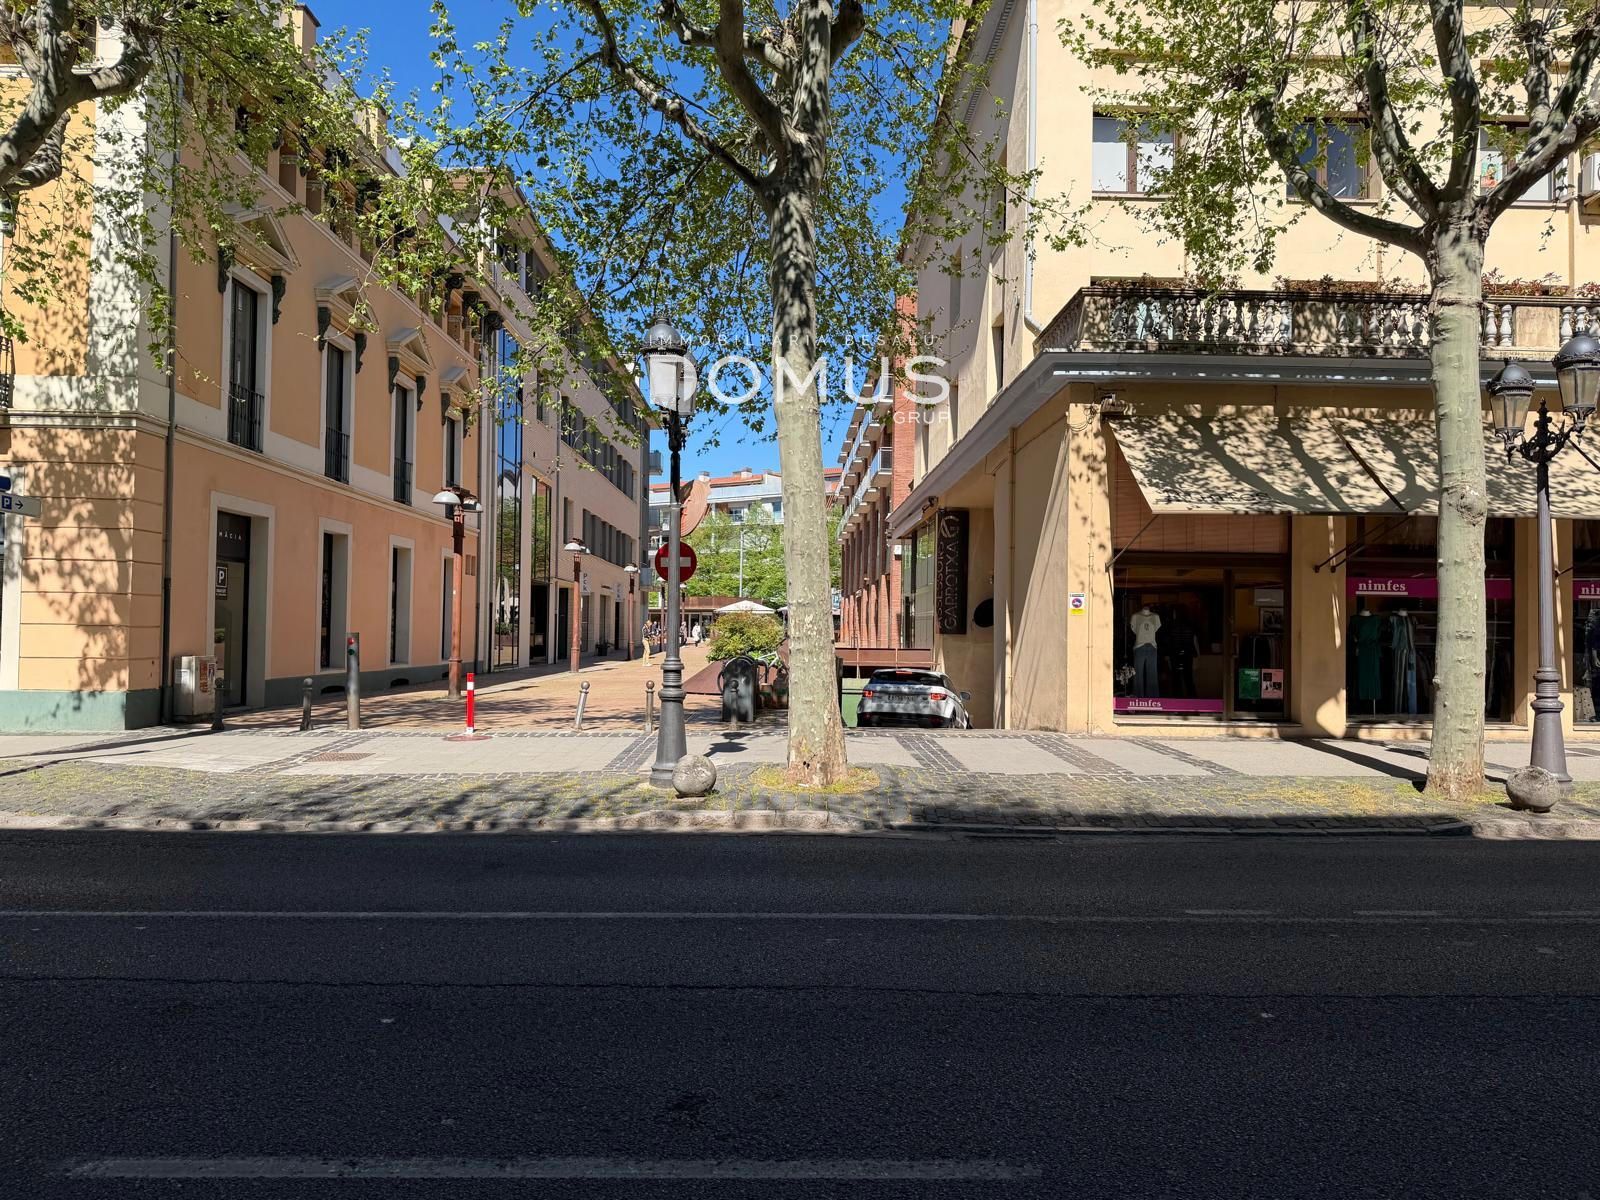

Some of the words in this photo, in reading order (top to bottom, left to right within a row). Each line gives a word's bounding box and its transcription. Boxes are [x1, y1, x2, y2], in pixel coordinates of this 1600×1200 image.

[218, 570, 225, 584] P
[944, 541, 959, 629] GARROTXA
[1358, 579, 1406, 591] nimfes
[1129, 698, 1161, 707] nimfes
